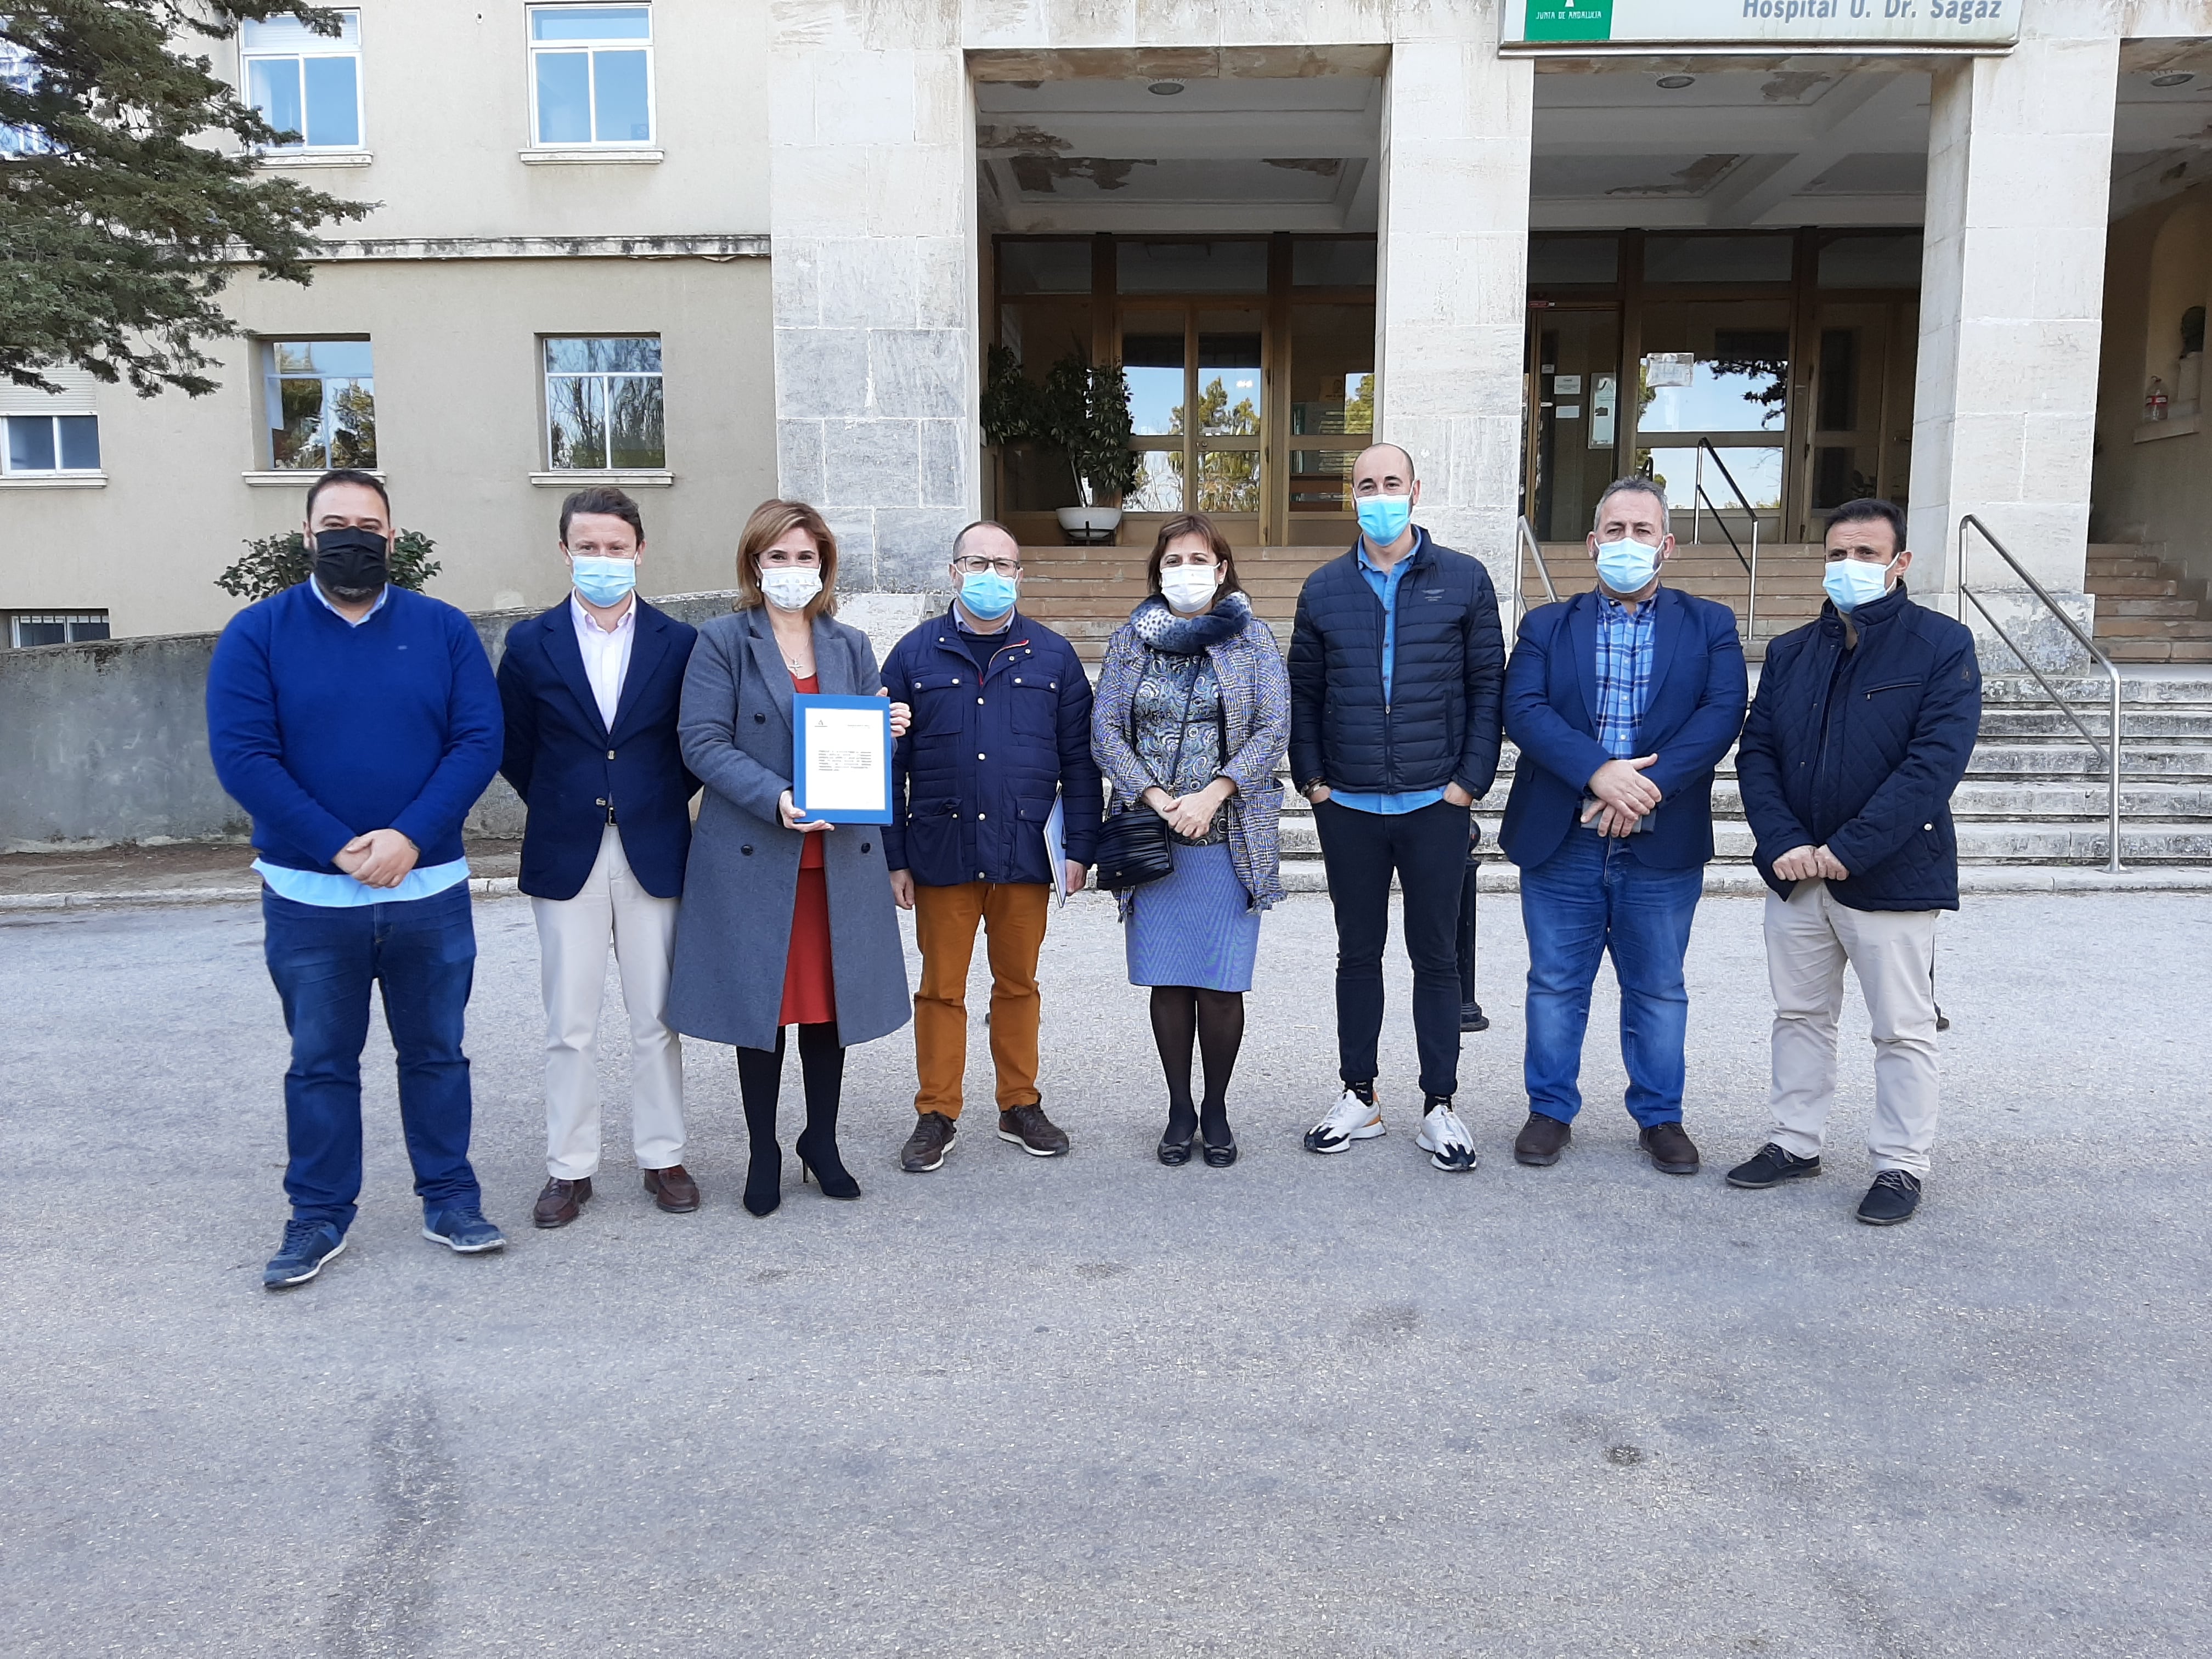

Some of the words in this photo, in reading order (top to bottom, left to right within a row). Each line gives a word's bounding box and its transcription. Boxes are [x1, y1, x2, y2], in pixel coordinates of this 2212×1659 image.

[1742, 0, 1838, 24] Hospital
[1884, 0, 1917, 18] Dr.
[1930, 0, 2002, 24] Sagaz
